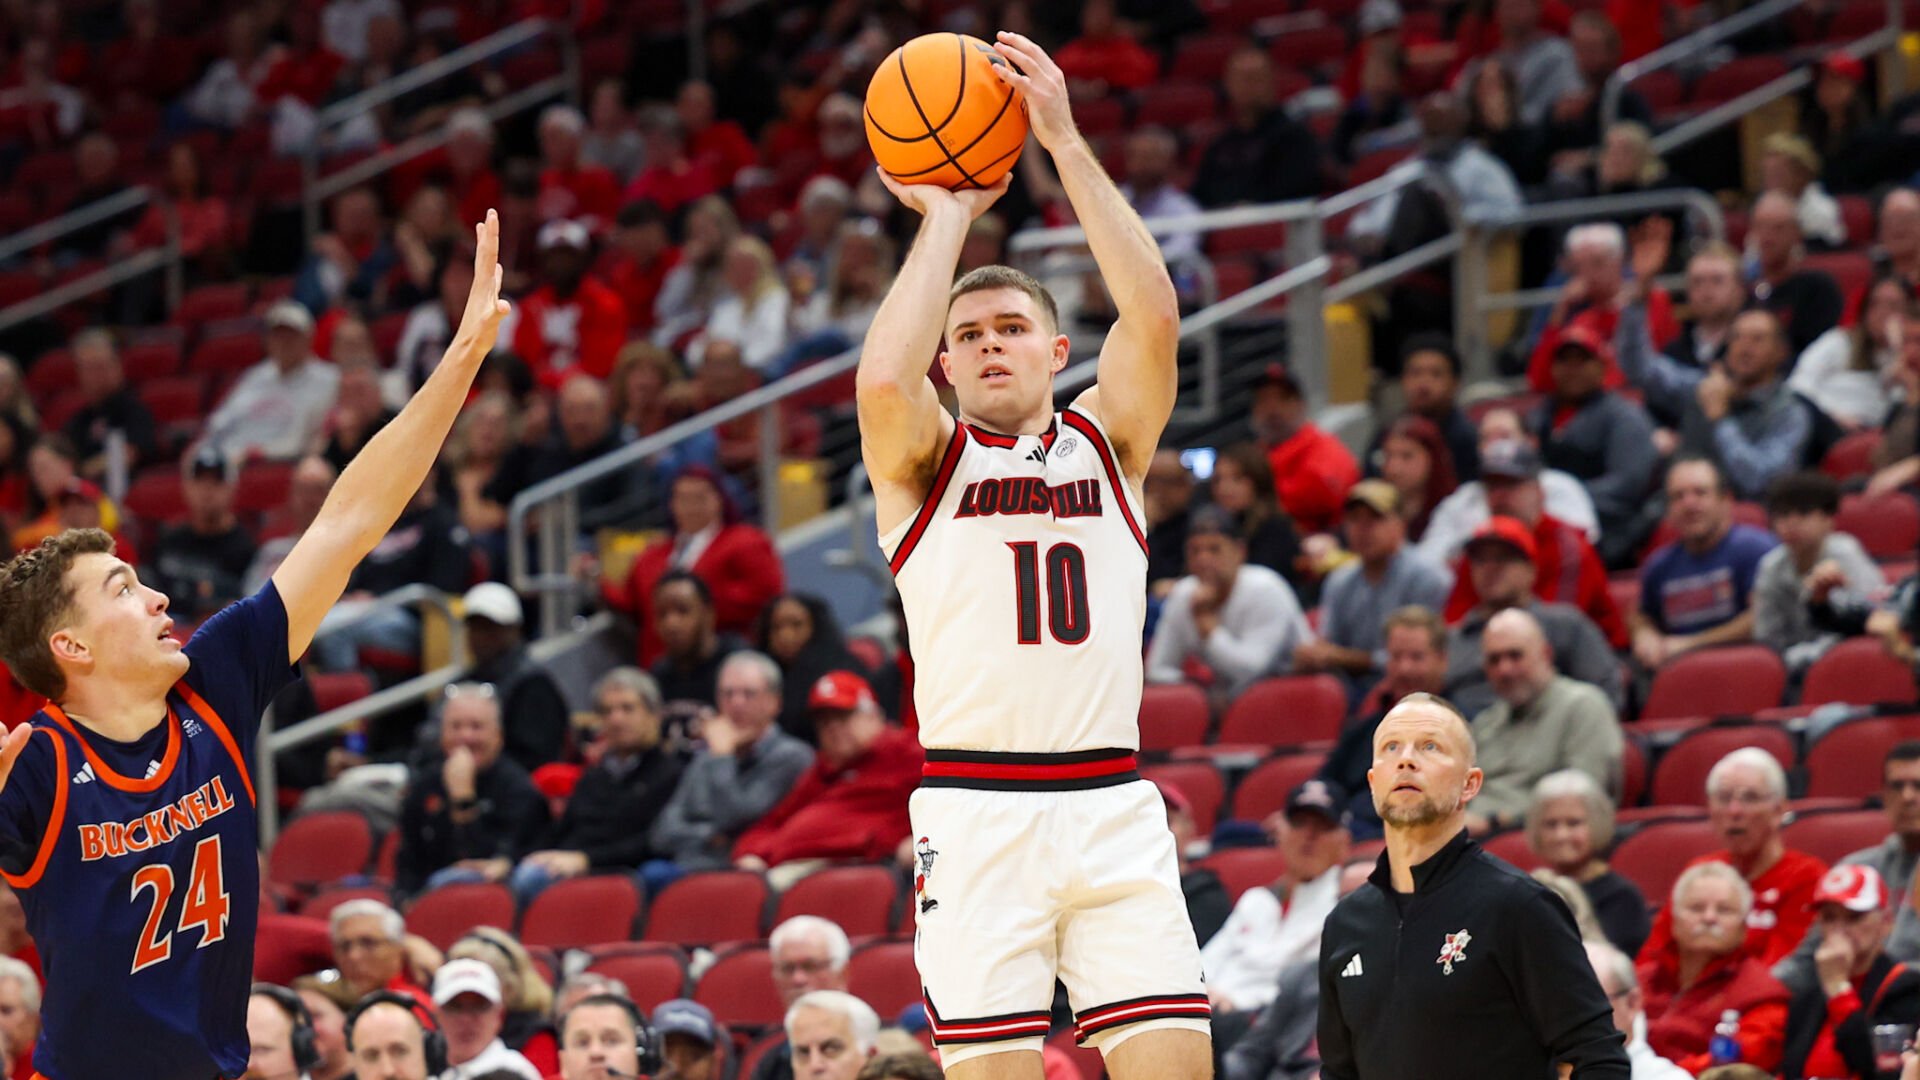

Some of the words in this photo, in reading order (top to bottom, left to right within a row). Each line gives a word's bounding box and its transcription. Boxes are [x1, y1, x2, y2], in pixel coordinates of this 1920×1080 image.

[953, 476, 1103, 522] LOUISILLE
[1004, 541, 1091, 645] 10
[78, 775, 235, 862] BUCKNELL
[130, 833, 230, 975] 24
